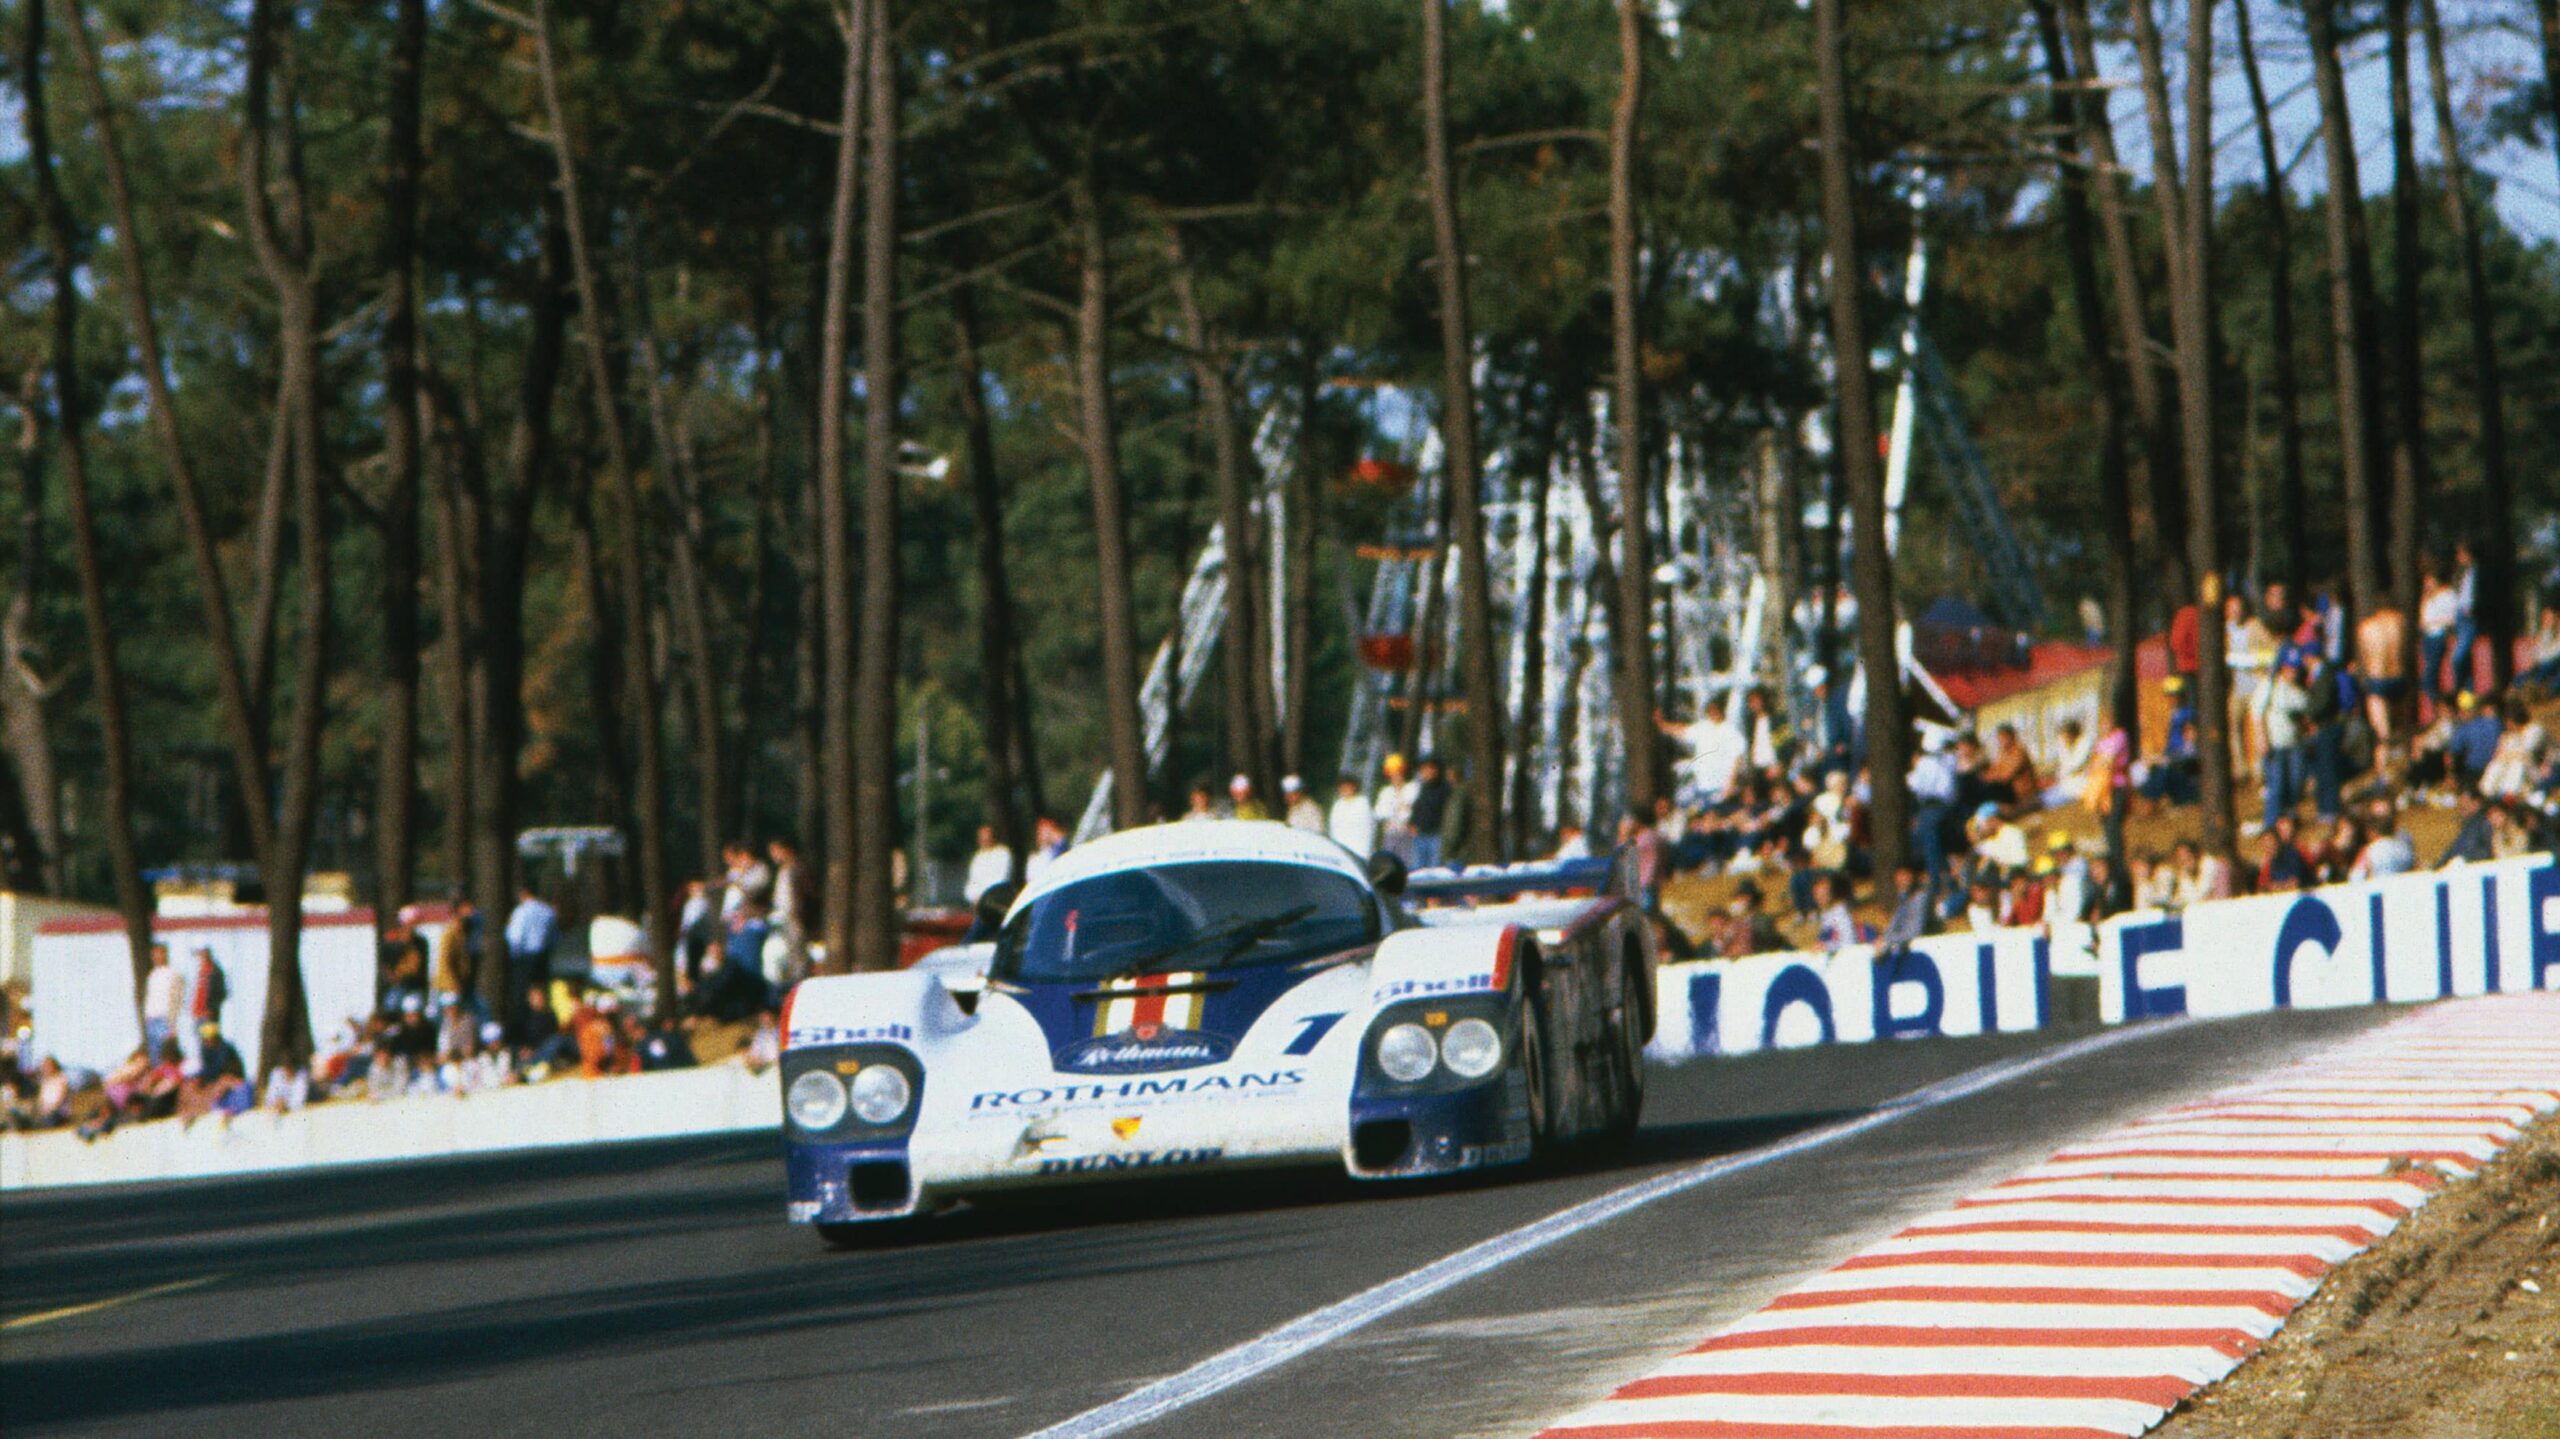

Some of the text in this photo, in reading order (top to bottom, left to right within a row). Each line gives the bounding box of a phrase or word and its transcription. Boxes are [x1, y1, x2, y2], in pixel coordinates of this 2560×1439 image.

[1374, 974, 1490, 1001] Shell
[789, 1024, 911, 1041] Shell
[1282, 1011, 1349, 1055] 1
[1078, 1044, 1210, 1065] Rothmans
[971, 1069, 1307, 1109] ROTHMANS
[1038, 1147, 1224, 1176] DUNLOP
